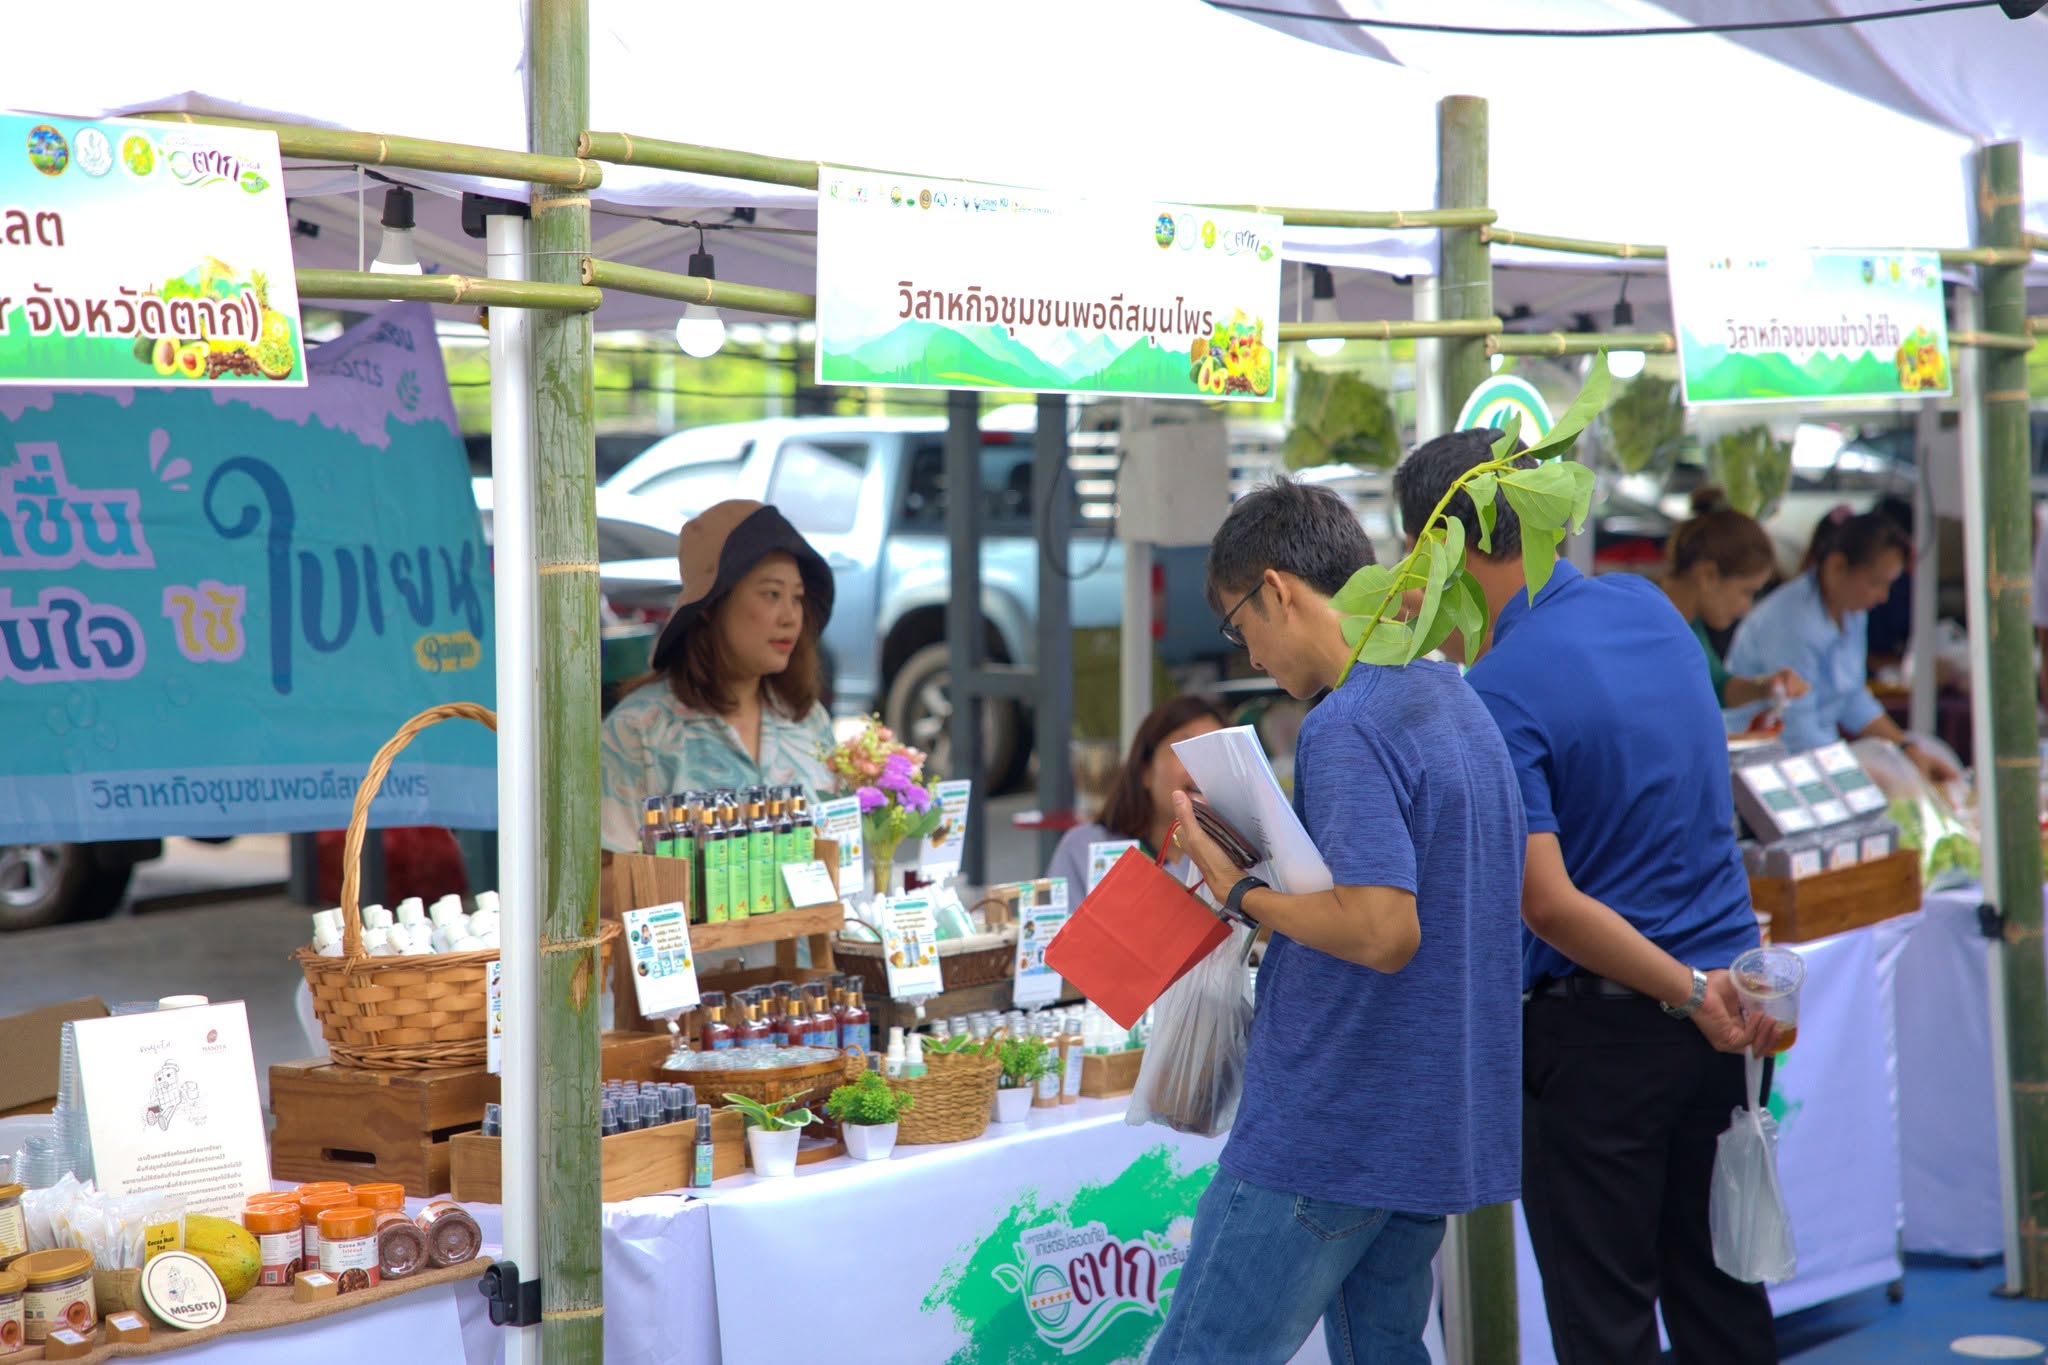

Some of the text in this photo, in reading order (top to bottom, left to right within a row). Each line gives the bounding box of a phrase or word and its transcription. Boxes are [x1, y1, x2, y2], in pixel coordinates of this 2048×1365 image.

[192, 150, 239, 182] ตาก
[0, 209, 65, 247] ลต
[27, 282, 258, 342] จังหวัดตาก)
[898, 281, 1214, 345] วิสาหกิจชุมชนพอดีสมุนไพร
[171, 589, 239, 655] ใช้
[91, 770, 430, 814] วิสาหกิจชุมชนพอดีสไพร
[1069, 1242, 1156, 1306] ตาก
[170, 1301, 218, 1315] MASOTA
